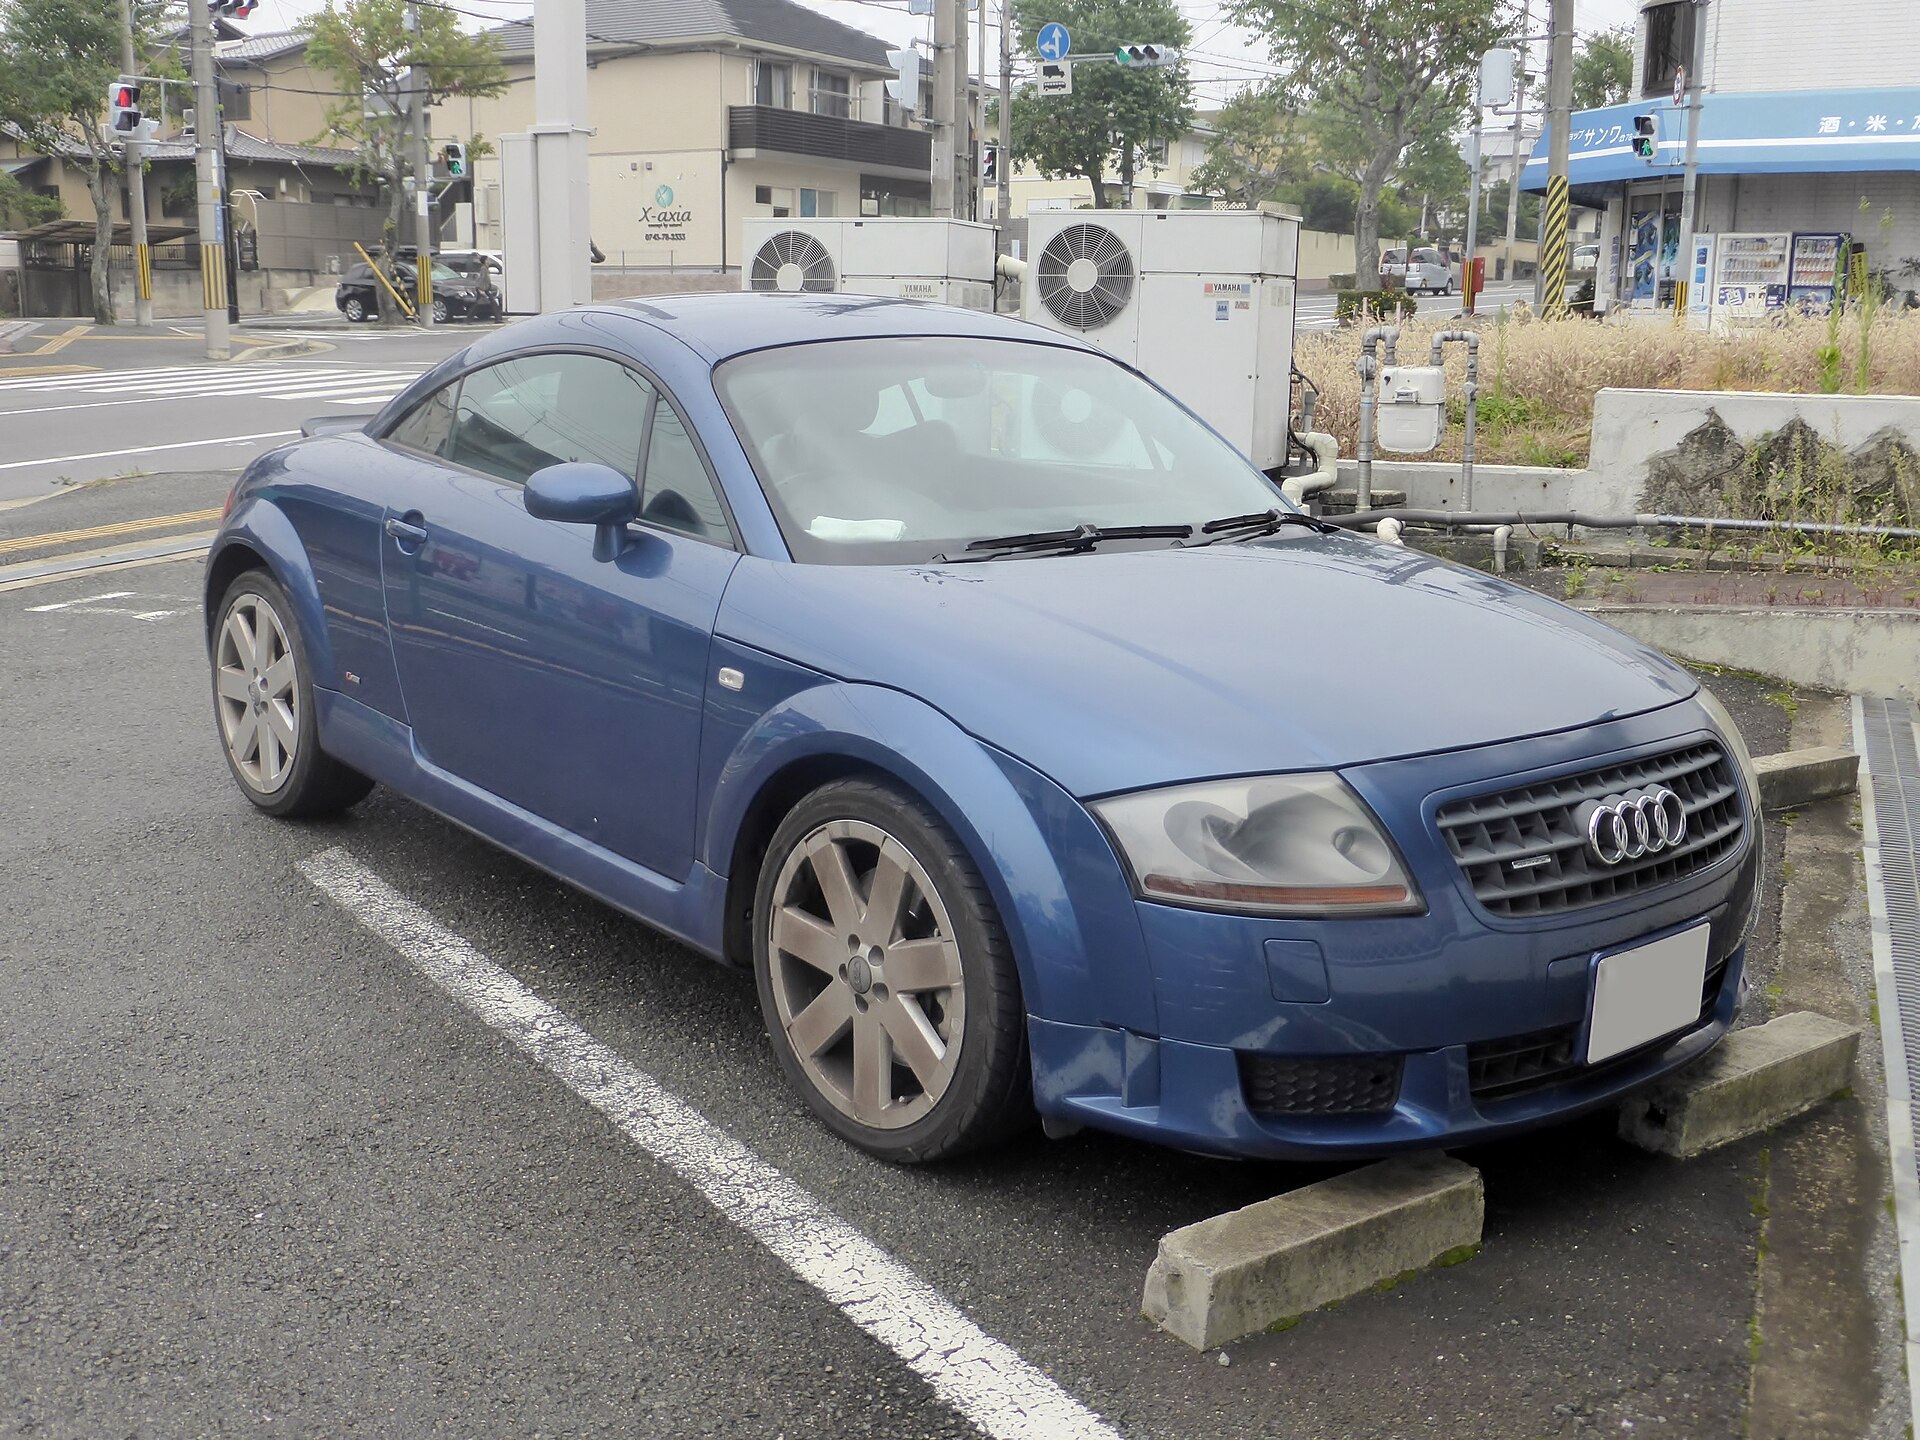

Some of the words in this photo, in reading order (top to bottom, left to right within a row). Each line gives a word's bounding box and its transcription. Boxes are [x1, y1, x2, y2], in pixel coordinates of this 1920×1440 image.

[638, 205, 692, 222] X-axia
[904, 284, 932, 293] YAMAHA
[1213, 283, 1241, 292] YAMAHA
